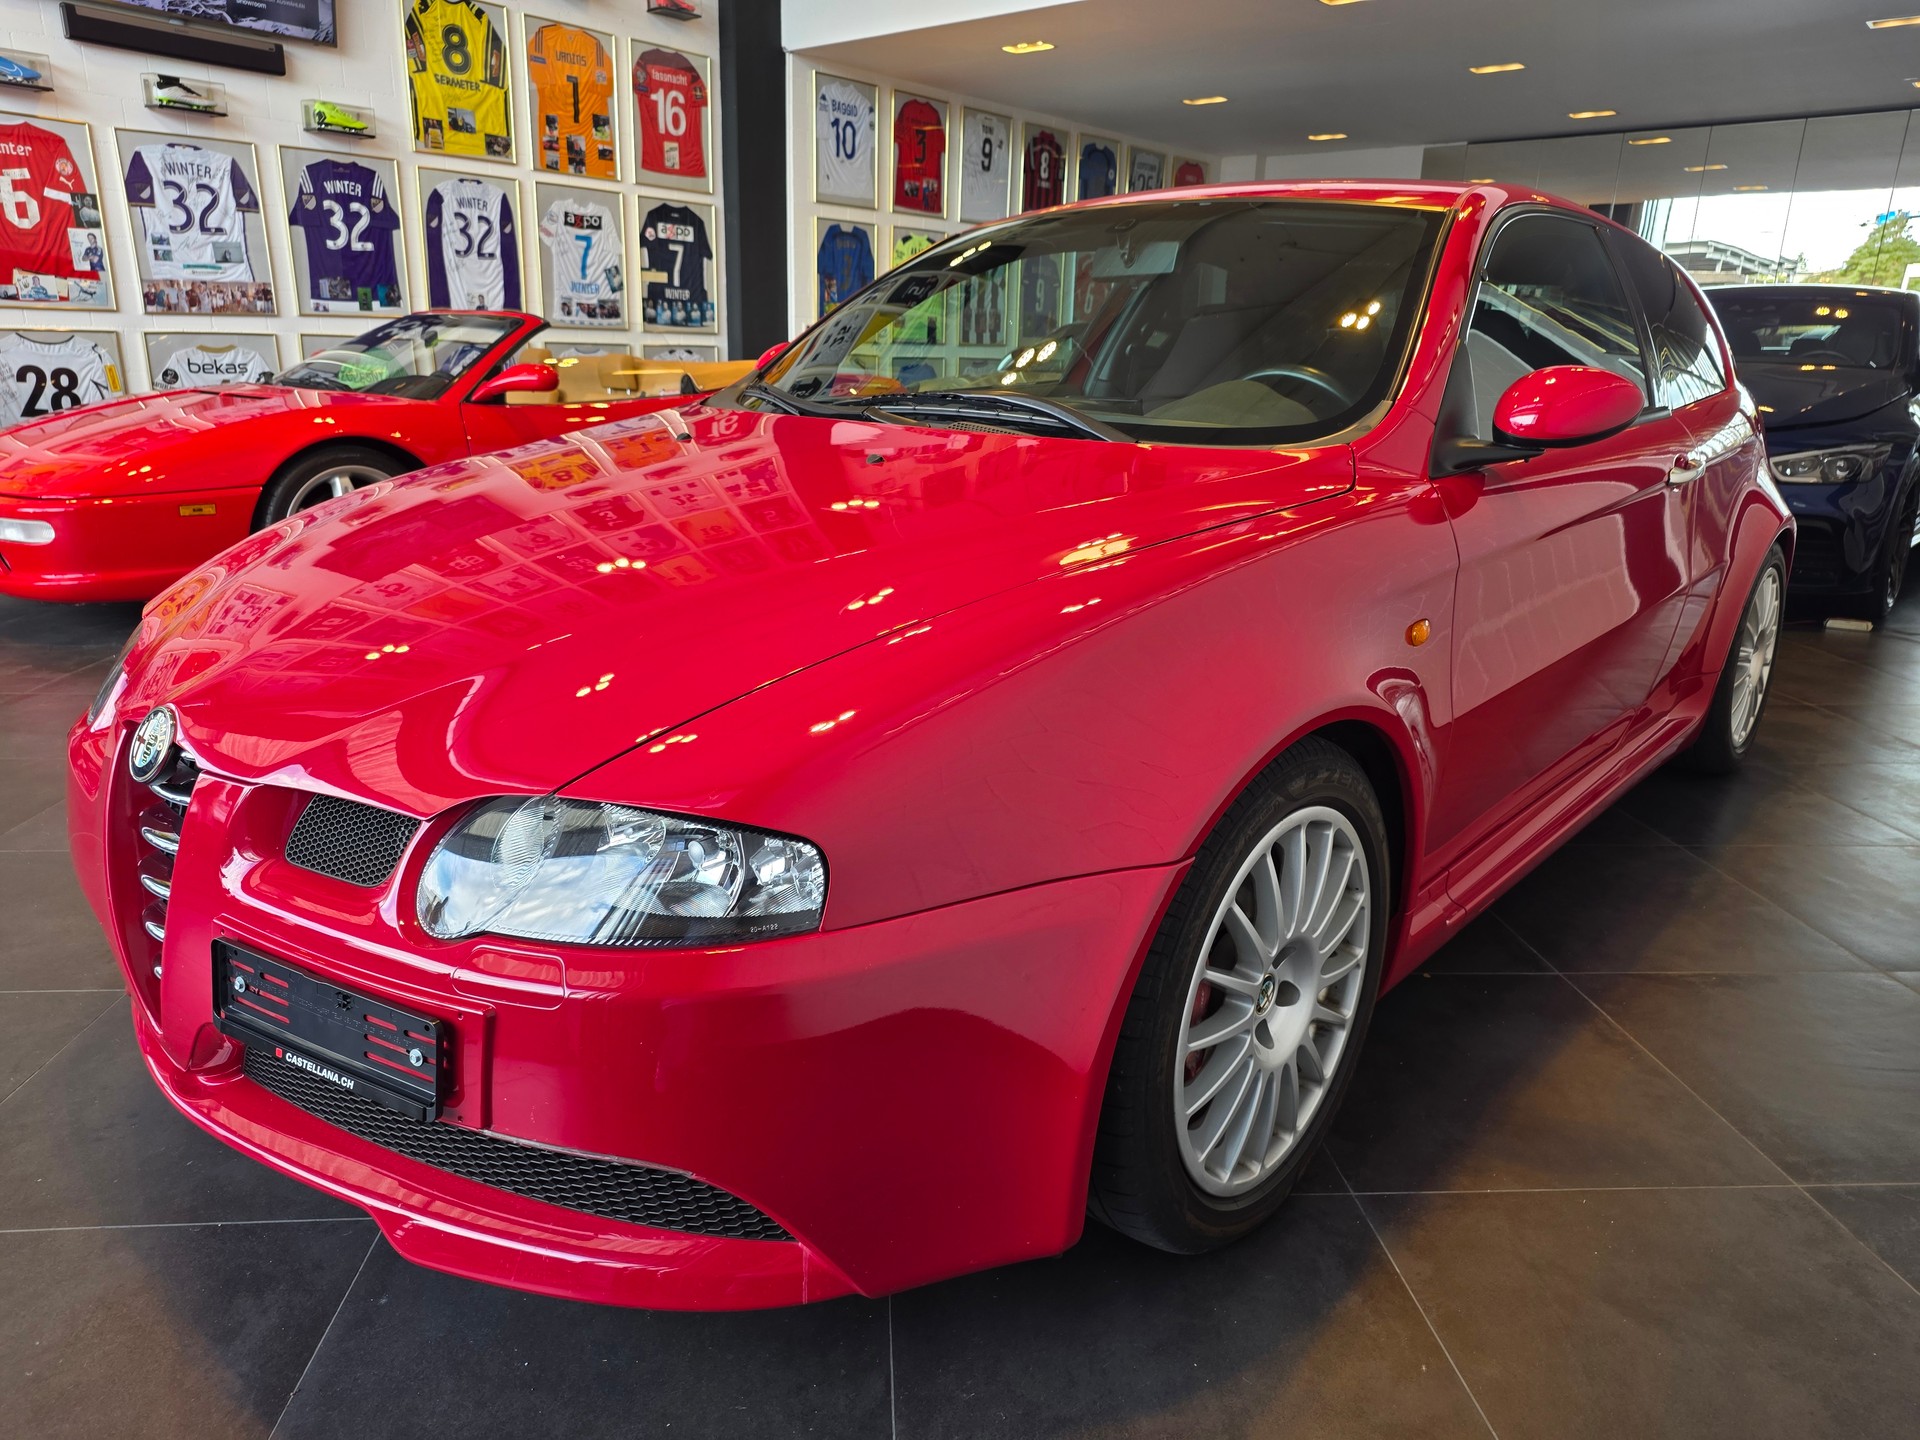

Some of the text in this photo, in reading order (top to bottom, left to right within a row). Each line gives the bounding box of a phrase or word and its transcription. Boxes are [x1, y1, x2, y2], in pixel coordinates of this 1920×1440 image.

[442, 23, 472, 75] 8
[566, 74, 580, 124] 1
[650, 88, 687, 137] 16
[0, 142, 32, 157] nter
[831, 117, 856, 160] 10
[914, 128, 927, 164] 3
[981, 137, 993, 172] 9
[165, 162, 212, 179] WINTER
[1040, 151, 1050, 180] 8
[323, 180, 362, 197] WINTER
[456, 197, 488, 212] WINTER
[163, 180, 228, 236] 32
[323, 199, 375, 251] 32
[453, 211, 498, 260] 32
[575, 234, 592, 280] 7
[668, 243, 684, 287] 7
[570, 280, 600, 295] WINTER
[665, 288, 691, 301] WINTER
[187, 358, 248, 376] bekaş
[16, 365, 82, 417] 28
[285, 1052, 354, 1089] CASTELLANA.CH
